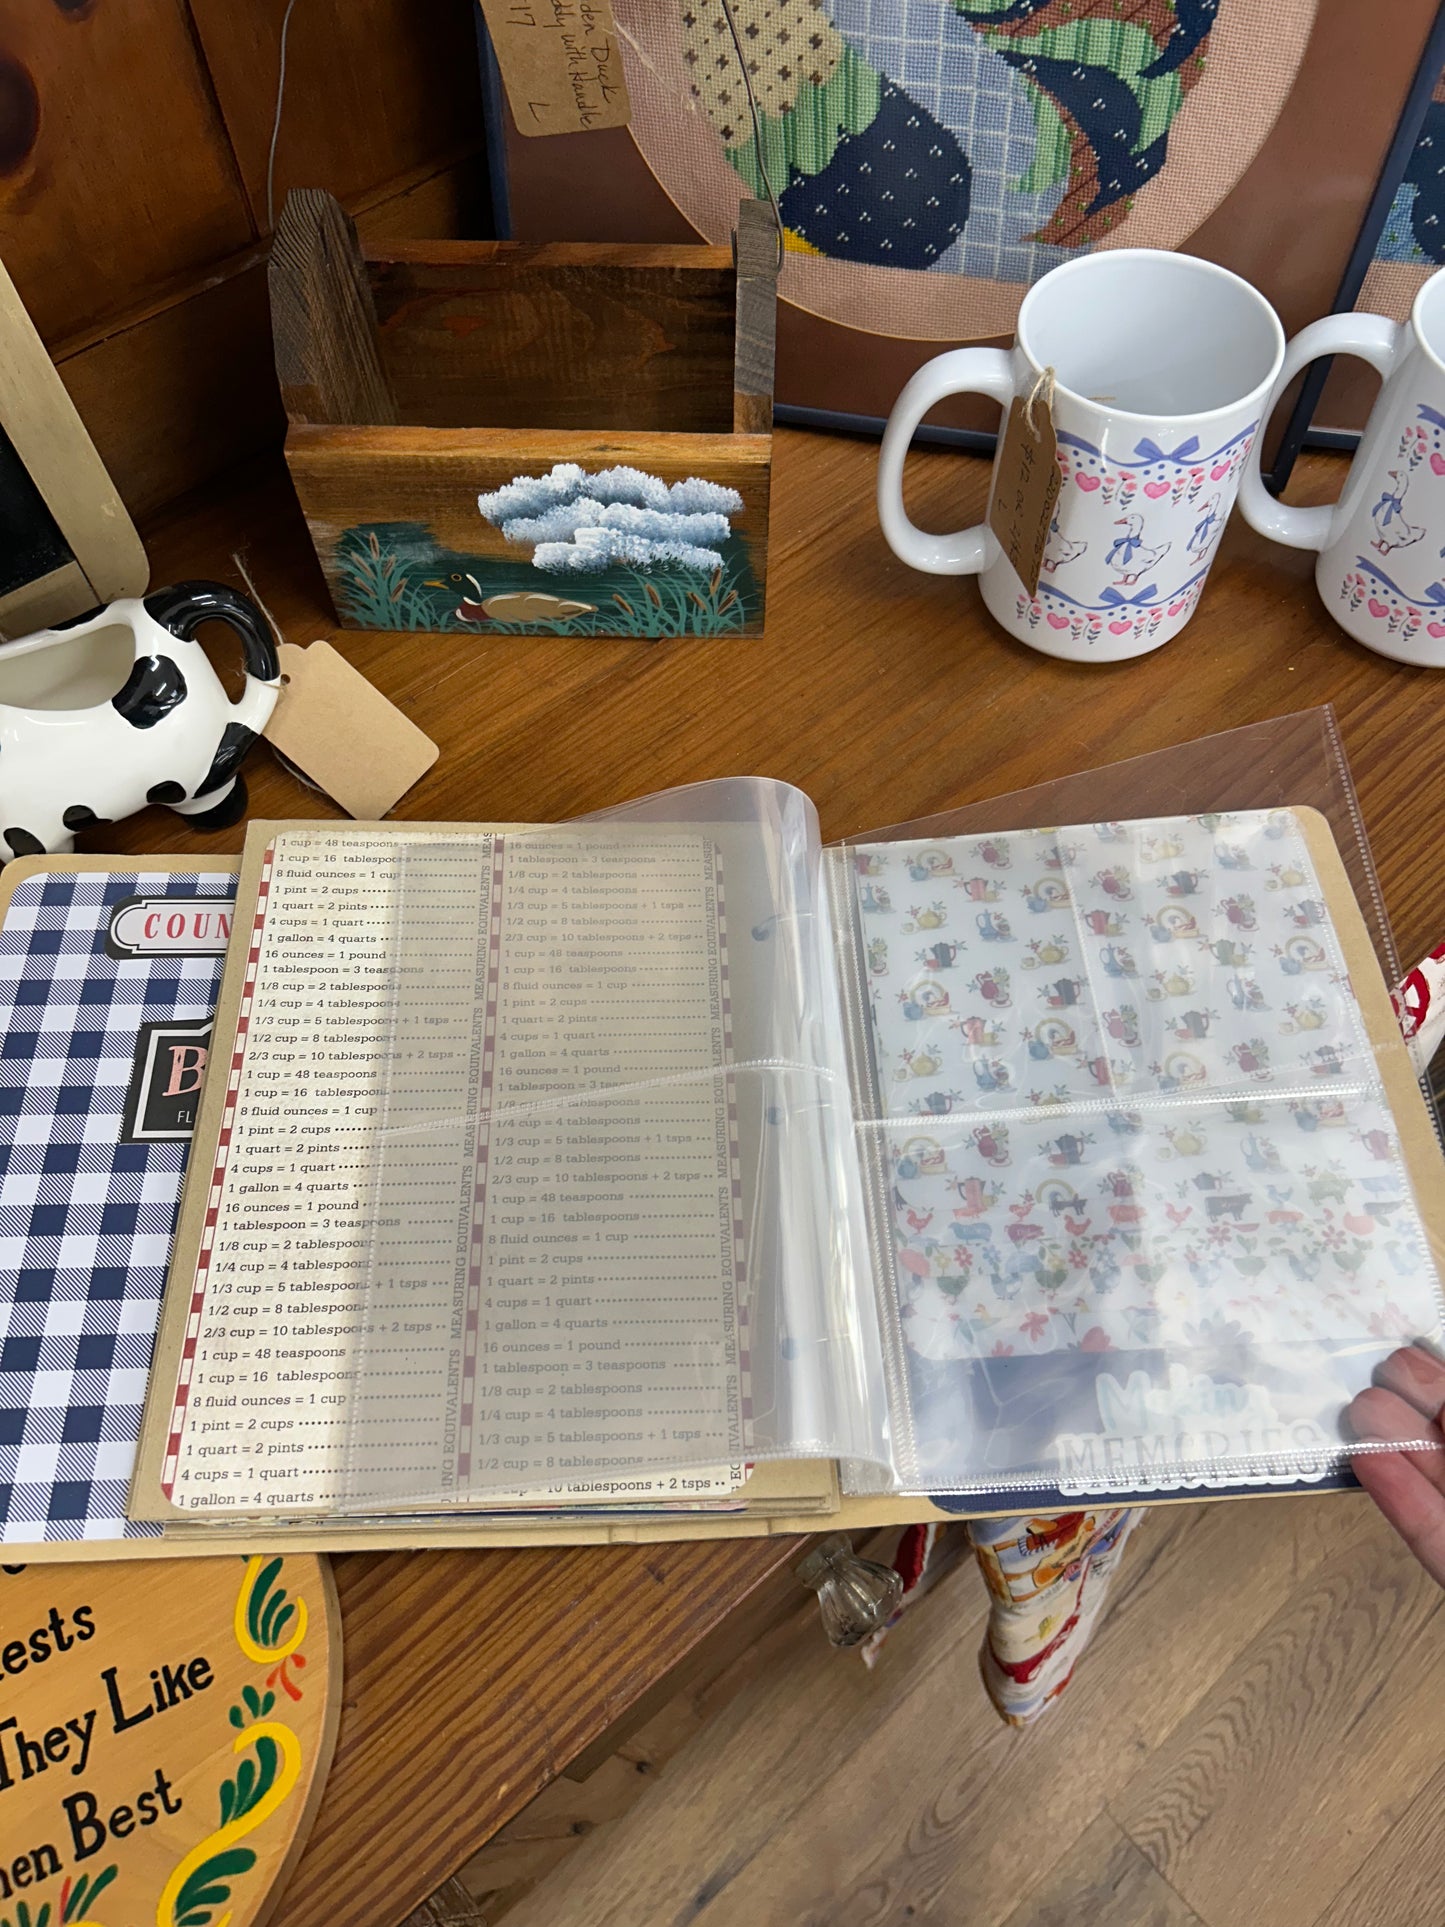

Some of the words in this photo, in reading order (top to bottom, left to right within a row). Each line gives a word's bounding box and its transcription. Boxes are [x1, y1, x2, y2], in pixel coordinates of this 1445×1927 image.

[561, 35, 586, 67] with
[591, 37, 621, 104] Duck
[569, 71, 601, 130] Handle
[281, 838, 286, 846] 1
[290, 840, 311, 848] cup
[342, 840, 401, 849] teaspoons
[276, 869, 283, 877] 8
[286, 869, 311, 877] fluid
[379, 872, 400, 880] cup
[284, 887, 307, 895] pint
[273, 901, 277, 909] 1
[282, 903, 313, 911] quart
[327, 902, 334, 910] 2
[338, 902, 367, 911] pints
[478, 865, 490, 935] EQUIVALENTS
[277, 934, 313, 943] gallon
[327, 934, 334, 942] 4
[338, 936, 376, 944] quarts
[348, 951, 386, 960] pound
[475, 937, 487, 1000] MEASURING
[511, 1016, 543, 1025] quart
[557, 1014, 564, 1023] 2
[568, 1014, 597, 1024] pints
[469, 1007, 483, 1084] EQUIVALENTS
[711, 1027, 724, 1105] EQUIALENTS
[247, 1070, 252, 1078] 1
[257, 1072, 280, 1080] cup
[295, 1070, 310, 1078] 48
[314, 1071, 377, 1080] teaspoons
[238, 1126, 243, 1134] 1
[248, 1127, 274, 1136] pint
[289, 1125, 297, 1134] 2
[301, 1127, 330, 1135] cups
[713, 1108, 728, 1178] MEASURING
[230, 1164, 238, 1173] 4
[242, 1166, 273, 1174] cups
[290, 1163, 295, 1172] 1
[300, 1163, 335, 1173] quart
[492, 1174, 512, 1184] 2/3
[515, 1176, 539, 1185] cup
[555, 1173, 569, 1182] 10
[572, 1171, 648, 1184] tablespoons
[663, 1171, 670, 1180] 2
[674, 1172, 700, 1182] tsps
[229, 1184, 233, 1192] 1
[239, 1182, 279, 1194] gallon
[294, 1182, 302, 1191] 4
[306, 1182, 348, 1193] quarts
[492, 1194, 497, 1204] 1
[502, 1196, 525, 1205] cup
[540, 1193, 556, 1202] 48
[559, 1192, 624, 1203] teaspoons
[226, 1203, 240, 1212] 16
[243, 1204, 290, 1212] ounces
[307, 1201, 312, 1210] 1
[317, 1200, 359, 1212] pound
[456, 1164, 473, 1253] EQUIVALENTS
[488, 1235, 496, 1244] 8
[500, 1234, 528, 1244] fluid
[532, 1235, 578, 1243] ounces
[595, 1232, 600, 1241] 1
[605, 1233, 628, 1243] cup
[718, 1186, 732, 1277] EQUIVALENTS
[451, 1257, 466, 1339] MEASURING
[485, 1320, 490, 1330] 1
[495, 1319, 536, 1332] gallon
[552, 1318, 561, 1328] 4
[564, 1318, 608, 1330] quarts
[720, 1281, 737, 1366] MEASURING
[483, 1342, 498, 1353] 16
[502, 1344, 550, 1352] ounces
[568, 1340, 573, 1350] 1
[578, 1339, 621, 1352] pound
[482, 1363, 488, 1373] 1
[493, 1360, 569, 1374] tablespoon
[585, 1360, 592, 1371] 3
[597, 1360, 666, 1373] teaspoons
[191, 1420, 196, 1431] 1
[202, 1420, 230, 1433] pint
[247, 1418, 256, 1429] 2
[260, 1420, 294, 1431] cups
[187, 1444, 192, 1455] 1
[198, 1445, 237, 1457] quart
[254, 1442, 263, 1453] 2
[268, 1442, 304, 1456] pints
[179, 1495, 184, 1506] 1
[190, 1493, 235, 1508] gallon
[253, 1492, 261, 1503] 4
[266, 1492, 314, 1505] quarts
[0, 1605, 96, 1681] ests
[0, 1709, 97, 1792] They
[100, 1656, 215, 1734] Like
[62, 1768, 183, 1862] Best
